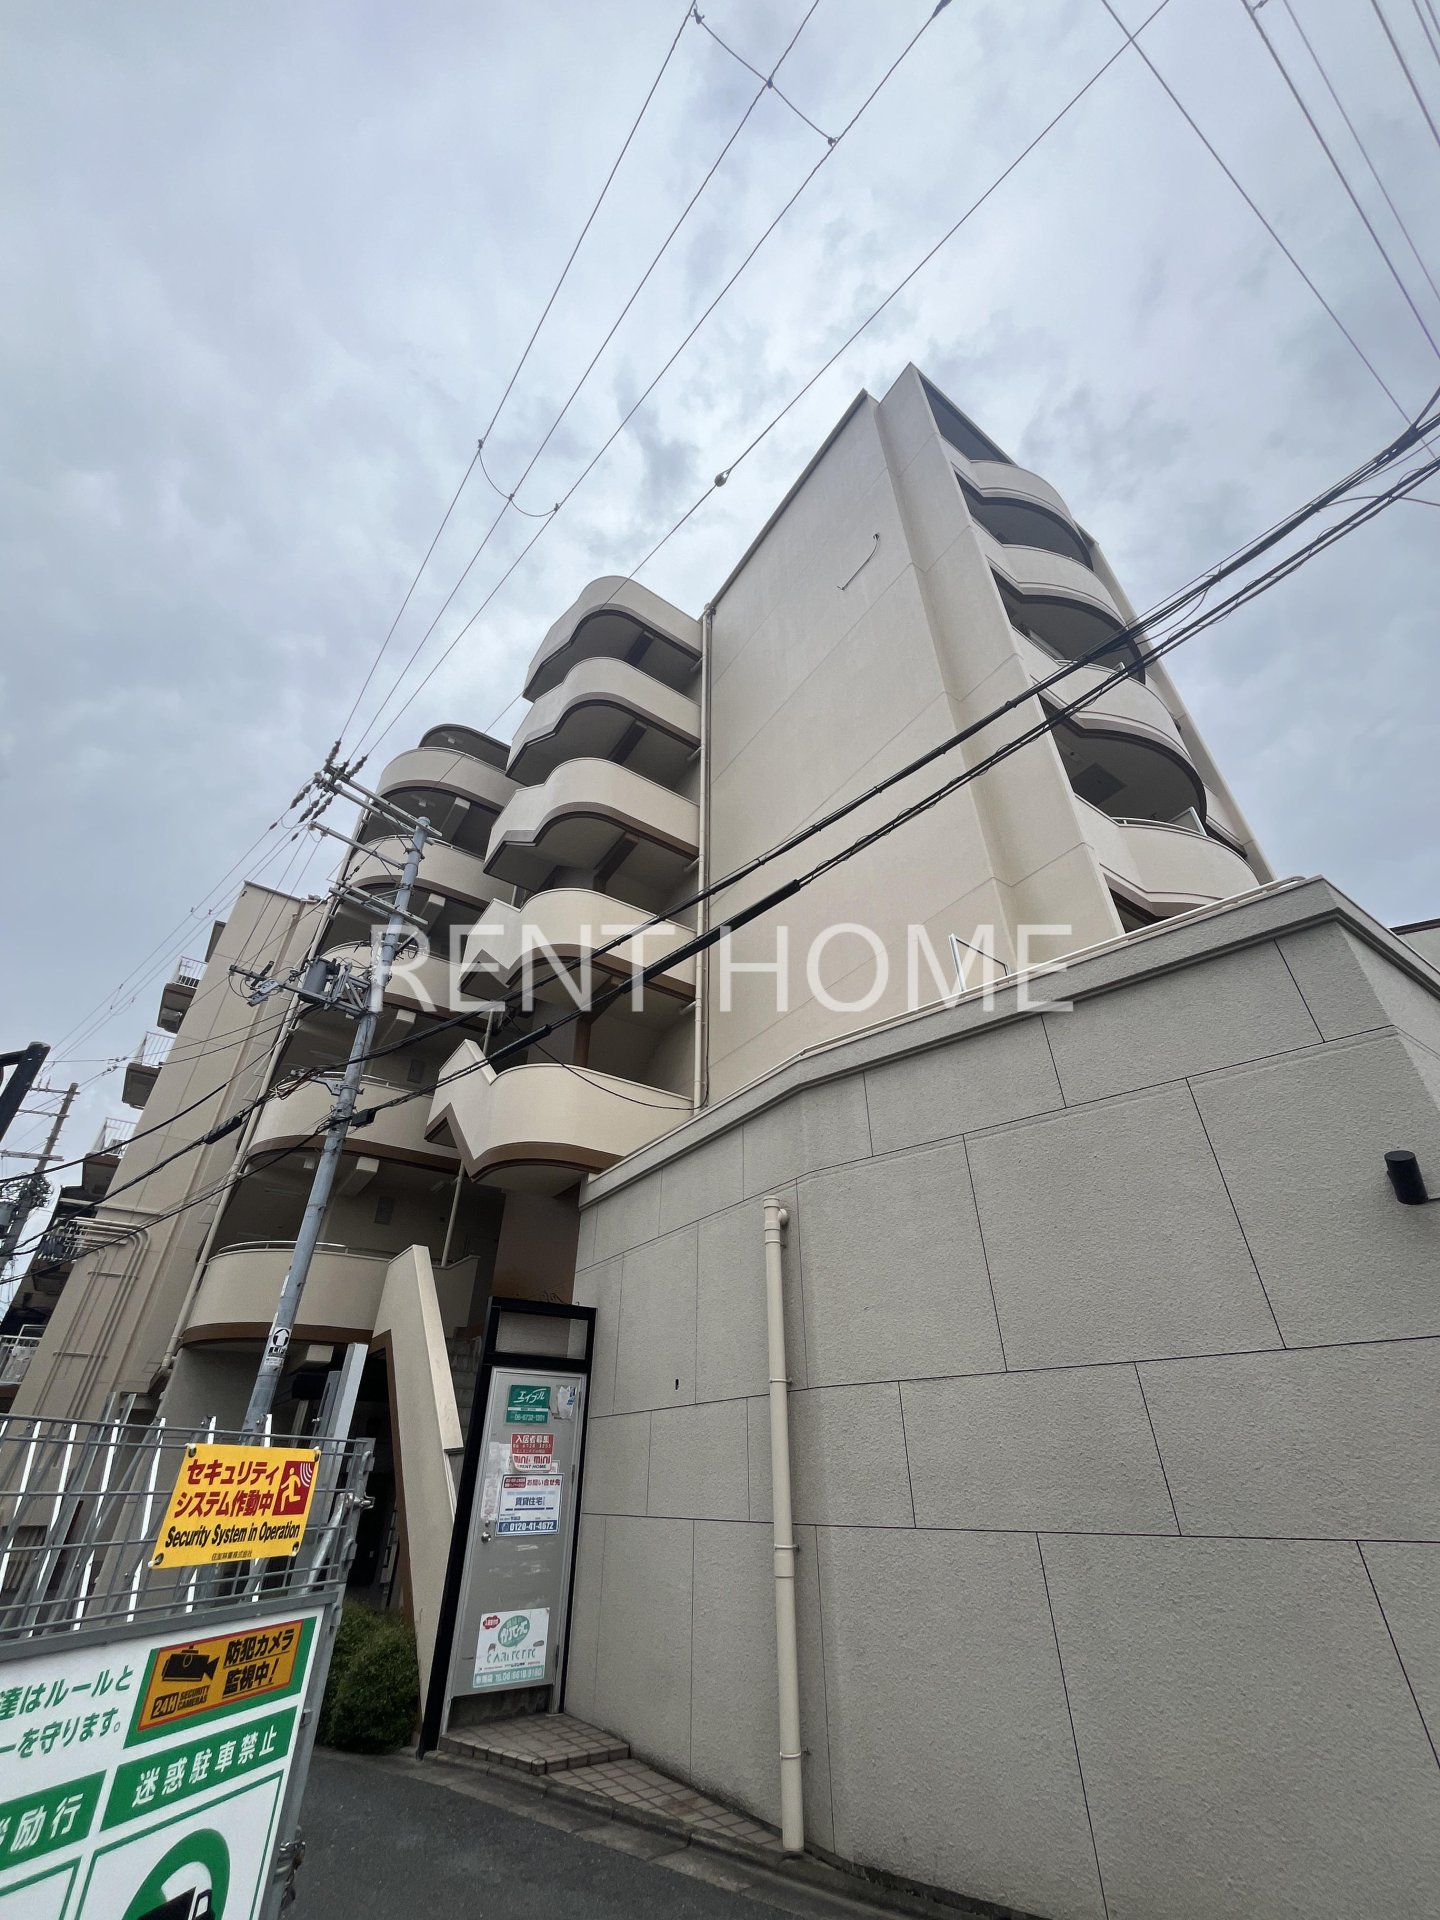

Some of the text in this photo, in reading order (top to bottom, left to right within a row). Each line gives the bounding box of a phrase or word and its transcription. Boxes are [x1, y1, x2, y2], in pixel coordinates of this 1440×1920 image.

[513, 1388, 547, 1404] エイブル
[187, 1459, 280, 1486] セキュリティ
[174, 1490, 275, 1518] システム作動中
[165, 1521, 301, 1548] Security System in Operation
[223, 1629, 295, 1667] 防犯カメラ
[152, 1696, 177, 1716] 24H
[131, 1724, 278, 1808] 迷惑駐車禁止
